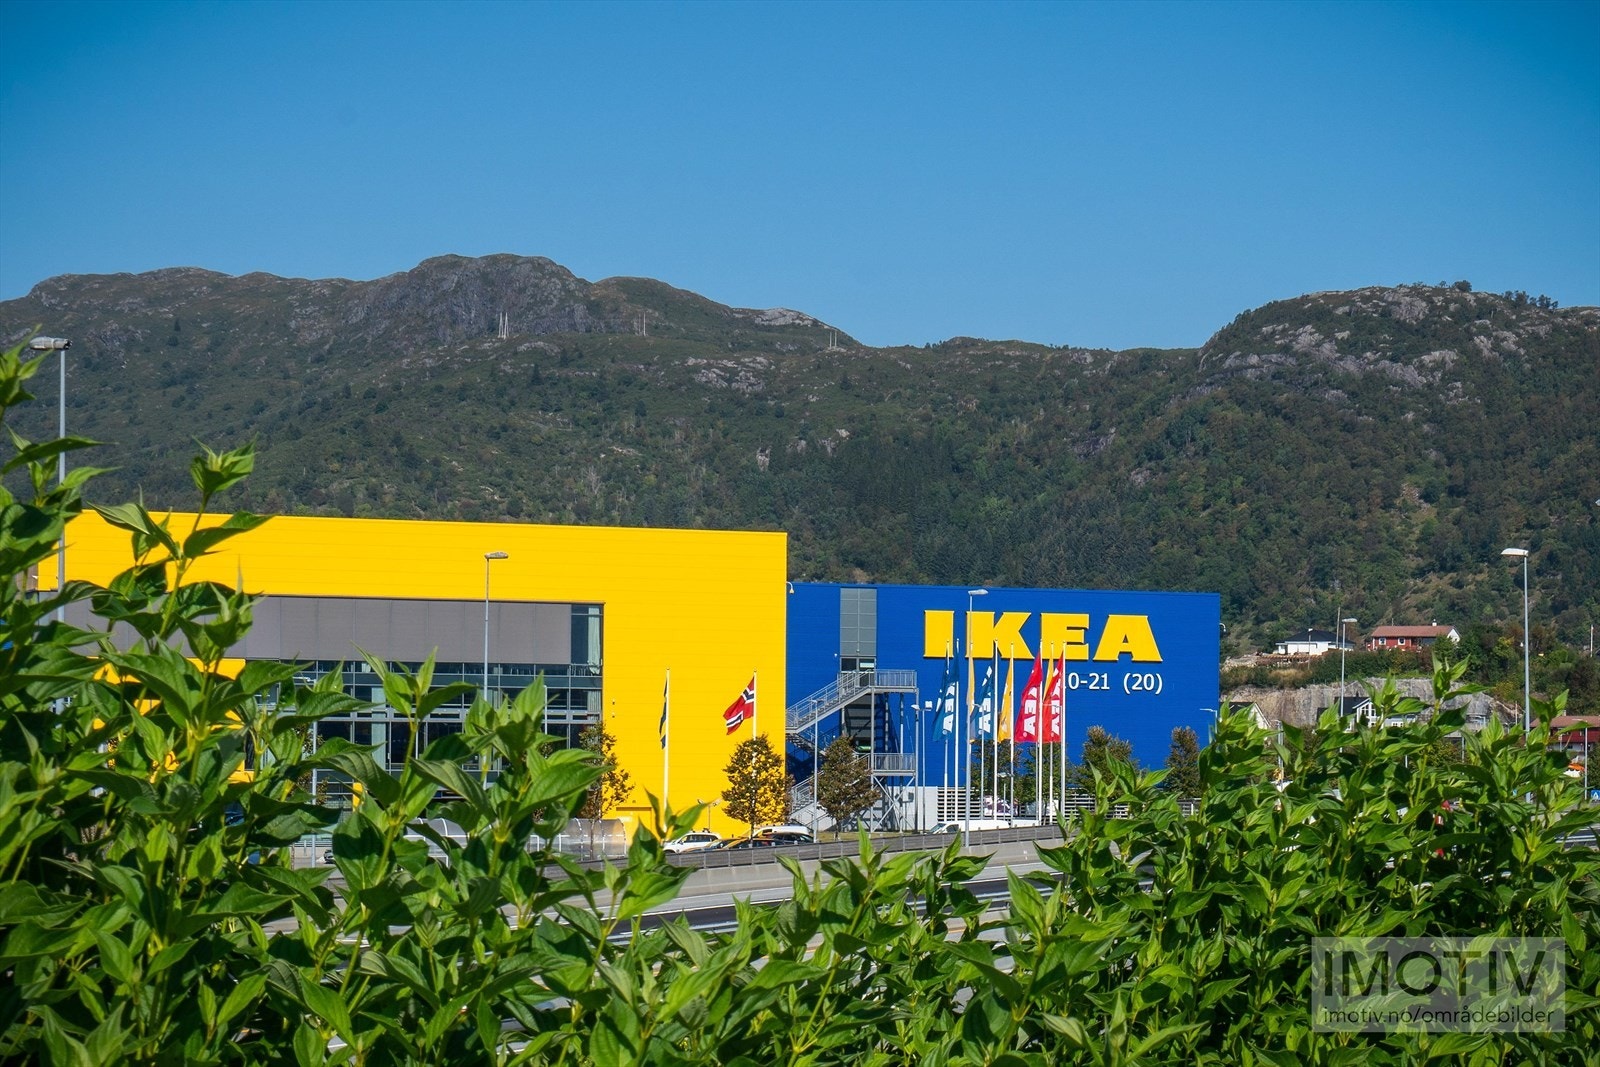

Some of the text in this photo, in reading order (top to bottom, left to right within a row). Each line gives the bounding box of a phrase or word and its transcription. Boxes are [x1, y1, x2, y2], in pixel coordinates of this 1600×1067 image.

[923, 610, 1163, 662] IKEA
[1064, 672, 1163, 695] 0-21 (20)
